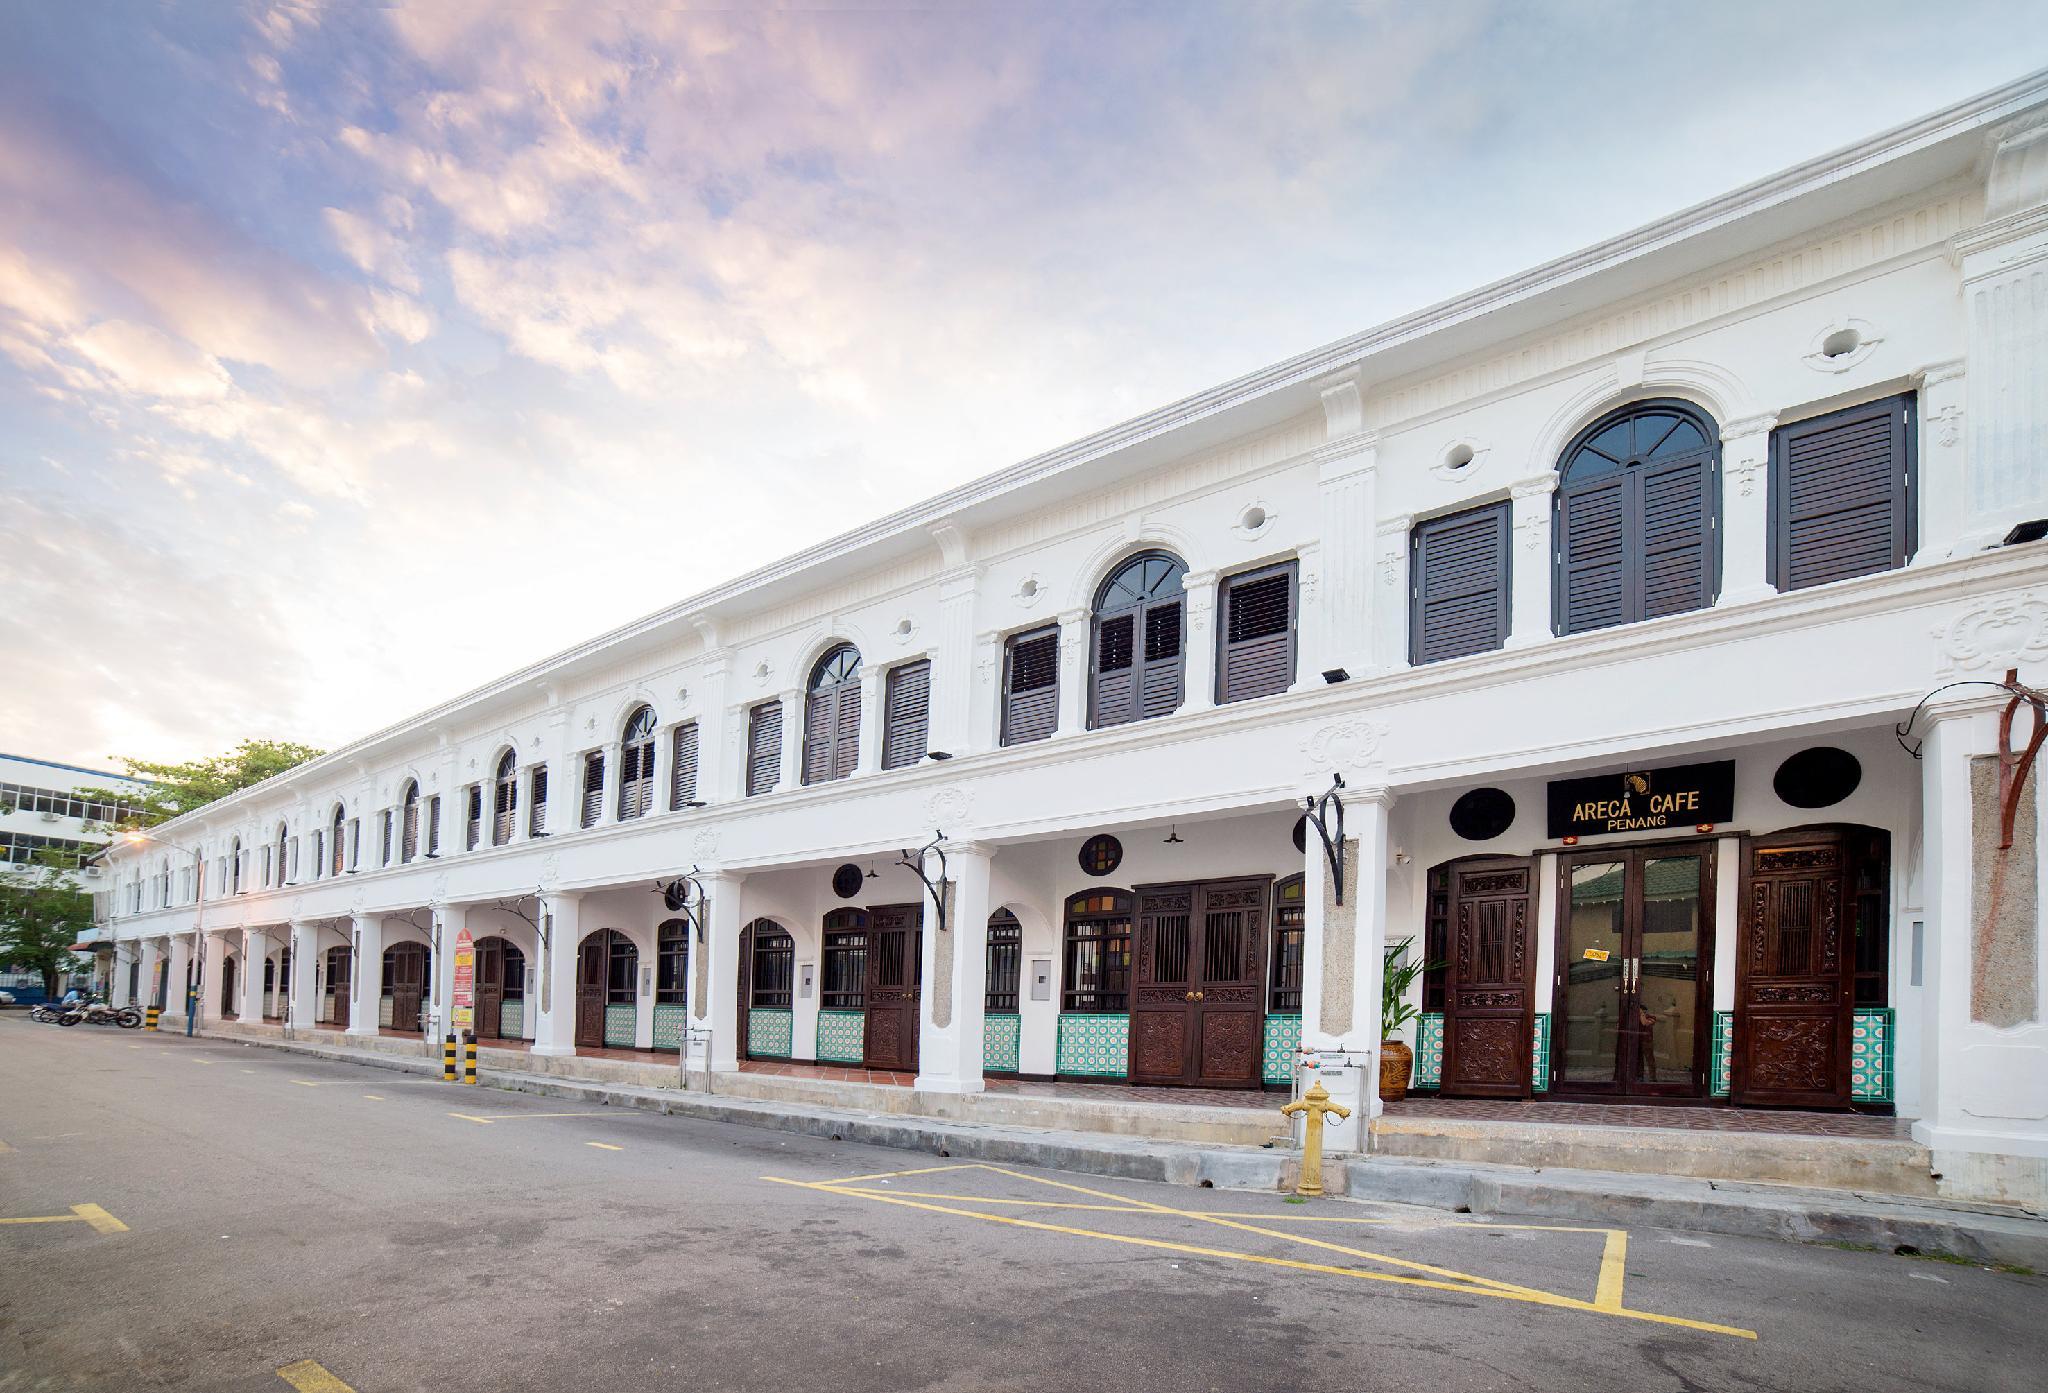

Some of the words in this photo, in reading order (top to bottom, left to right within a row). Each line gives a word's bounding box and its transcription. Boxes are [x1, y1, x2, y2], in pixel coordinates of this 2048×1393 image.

[1573, 799, 1631, 821] ARECA
[1650, 791, 1699, 813] CAFE
[1608, 815, 1666, 831] PENANG
